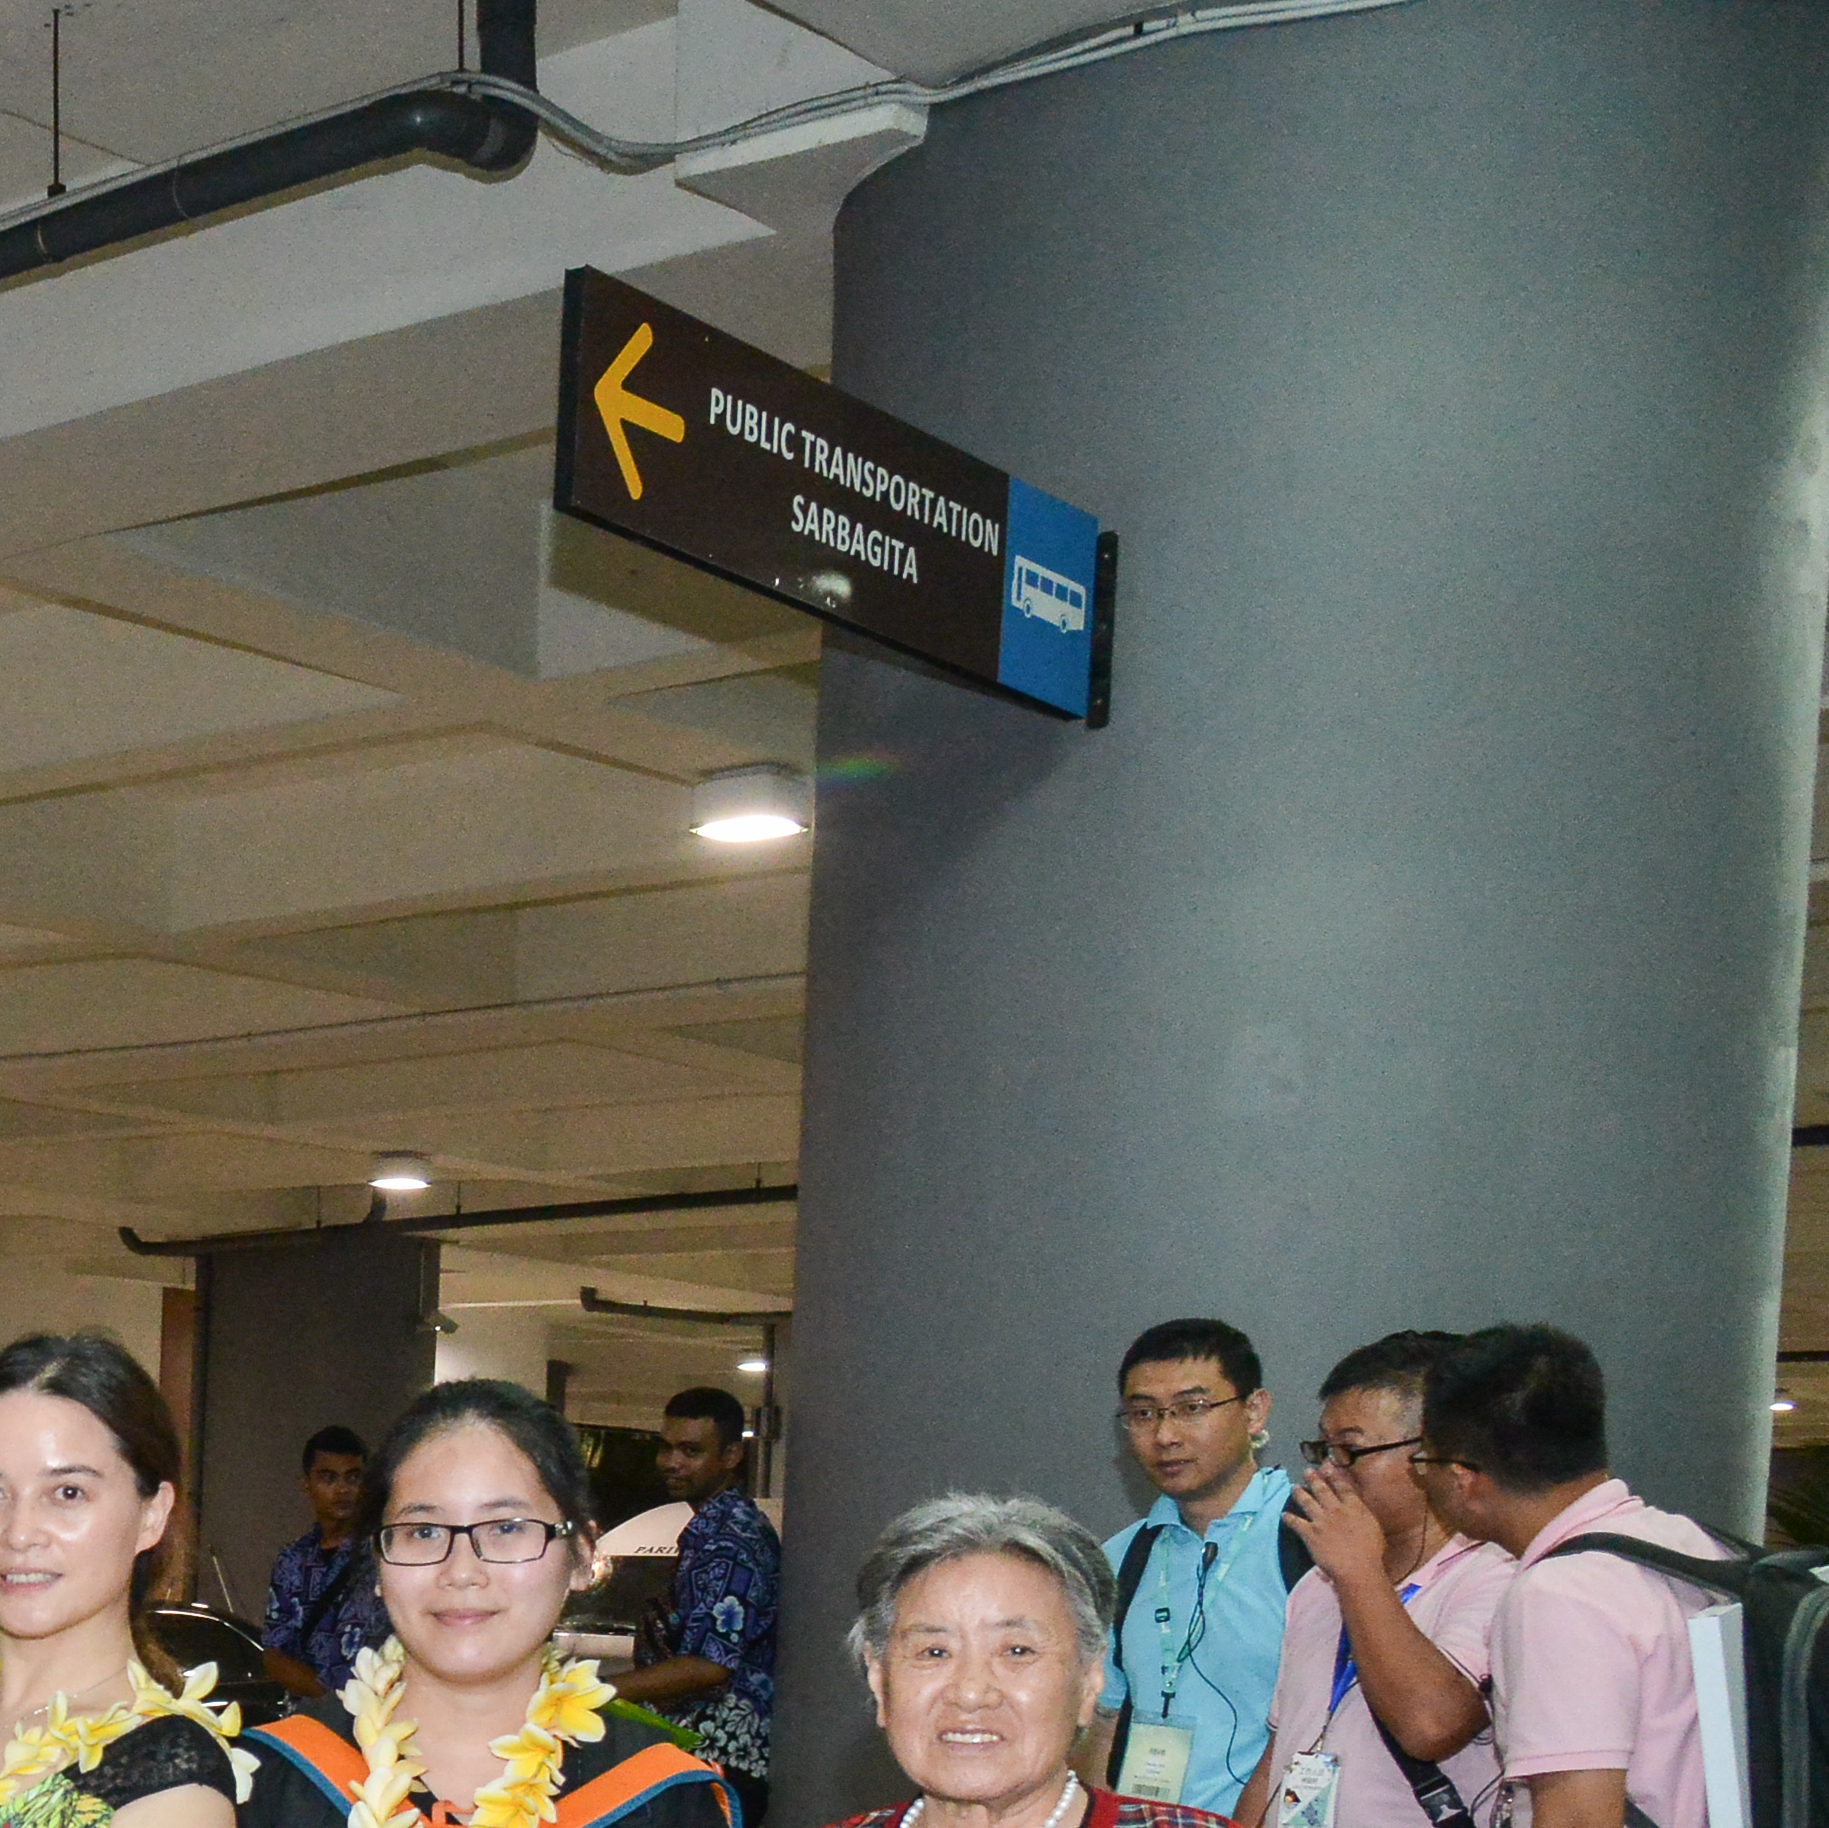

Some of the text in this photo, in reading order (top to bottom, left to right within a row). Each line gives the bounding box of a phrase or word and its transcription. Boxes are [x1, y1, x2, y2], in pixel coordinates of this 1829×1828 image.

[709, 387, 1000, 557] PUBLIC TRANSPORTATION
[791, 494, 919, 585] SARBAGITA
